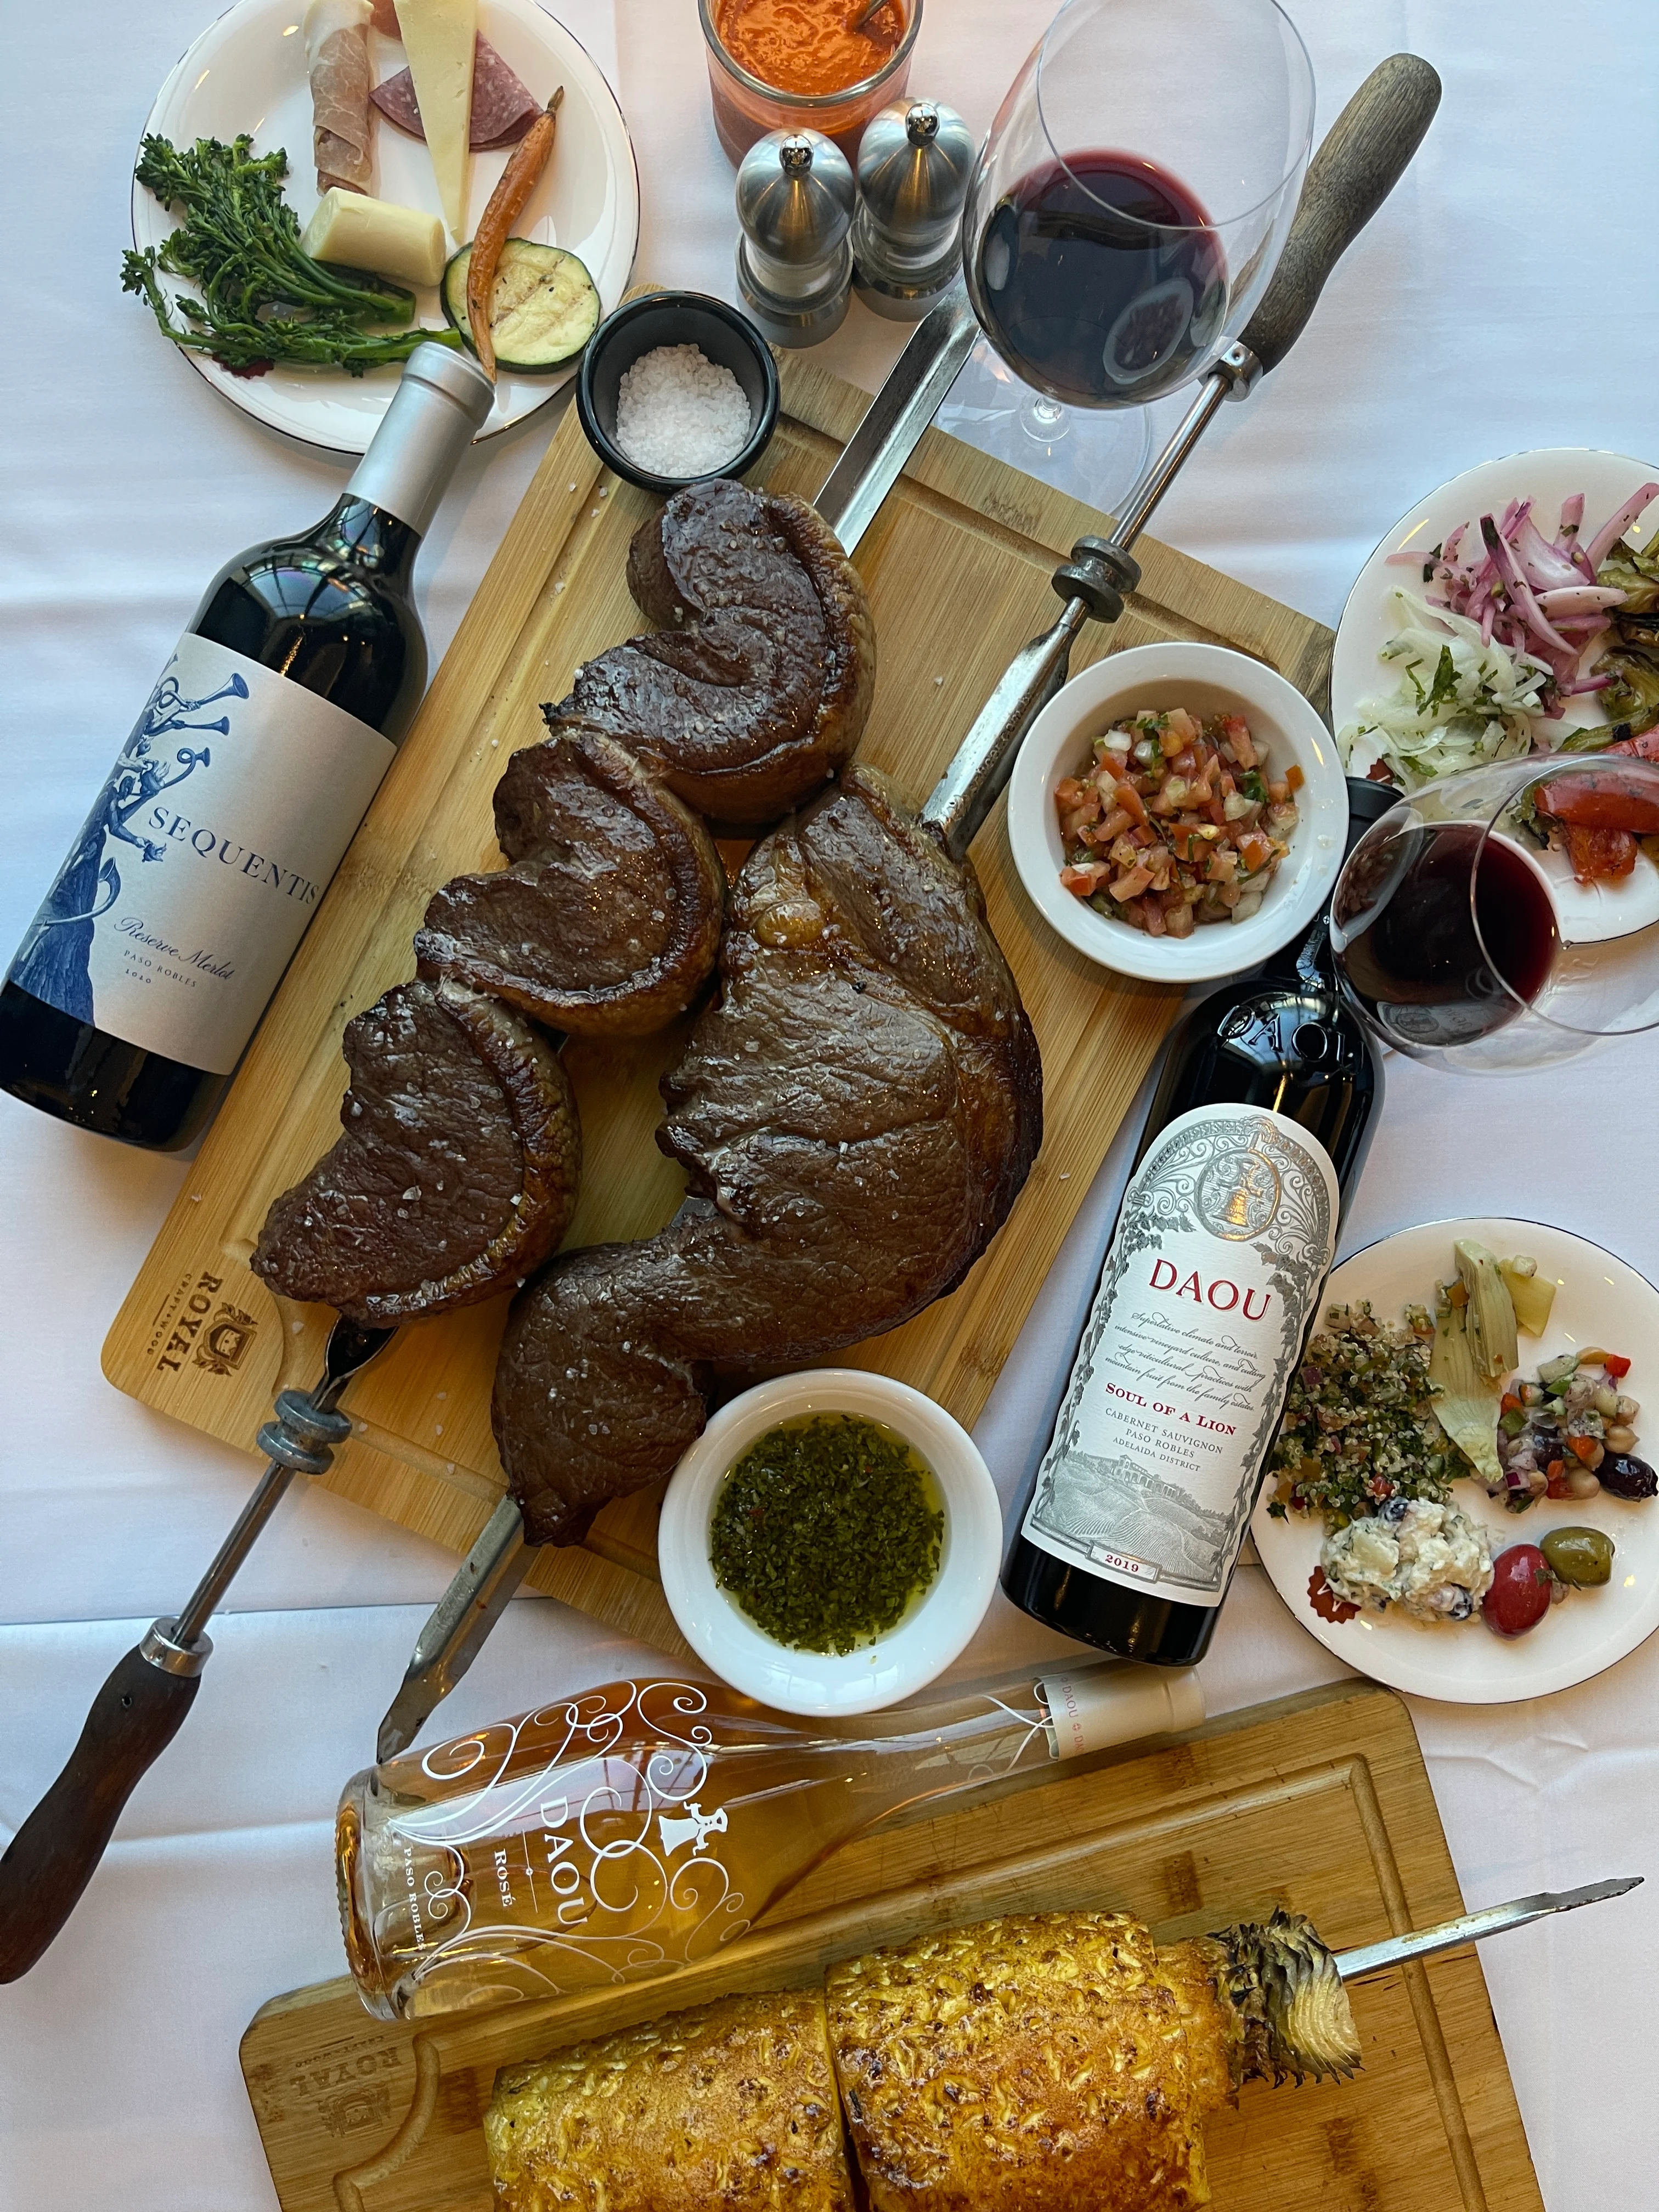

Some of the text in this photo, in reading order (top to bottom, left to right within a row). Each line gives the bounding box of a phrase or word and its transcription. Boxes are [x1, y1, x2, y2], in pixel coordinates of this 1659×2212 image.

[148, 806, 319, 905] SEQUENTIS
[114, 917, 235, 980] Reserve Merlot
[124, 949, 198, 988] PASO ROBLES
[1149, 1259, 1272, 1321] DAOU
[156, 1271, 223, 1372] ROYAL
[1131, 1312, 1181, 1334] Superlative
[1181, 1328, 1214, 1345] climate
[1215, 1342, 1236, 1351] and
[1105, 1352, 1142, 1374] mountain
[1114, 1323, 1147, 1340] intensive
[1147, 1336, 1194, 1355] vineyard
[1189, 1351, 1221, 1367] culture,
[1223, 1362, 1245, 1372] and
[1118, 1344, 1252, 1393] edge viticultural practices with
[1136, 1367, 1164, 1381] fruit
[1156, 1375, 1185, 1390] from
[1105, 1382, 1237, 1436] SOUL OF A LION
[1186, 1384, 1203, 1395] the
[1194, 1387, 1233, 1410] family
[1105, 1407, 1223, 1454] CABERNET SAUVIGNON
[1125, 1428, 1195, 1458] PASO ROBLES
[1112, 1436, 1201, 1472] ADELAIDA DISTRICT
[1105, 1554, 1139, 1572] 2019
[1062, 1685, 1079, 1718] DAOU
[404, 1847, 415, 1887] PASO
[494, 1848, 516, 1907] ROSÉ
[540, 1796, 588, 1925] DAOU
